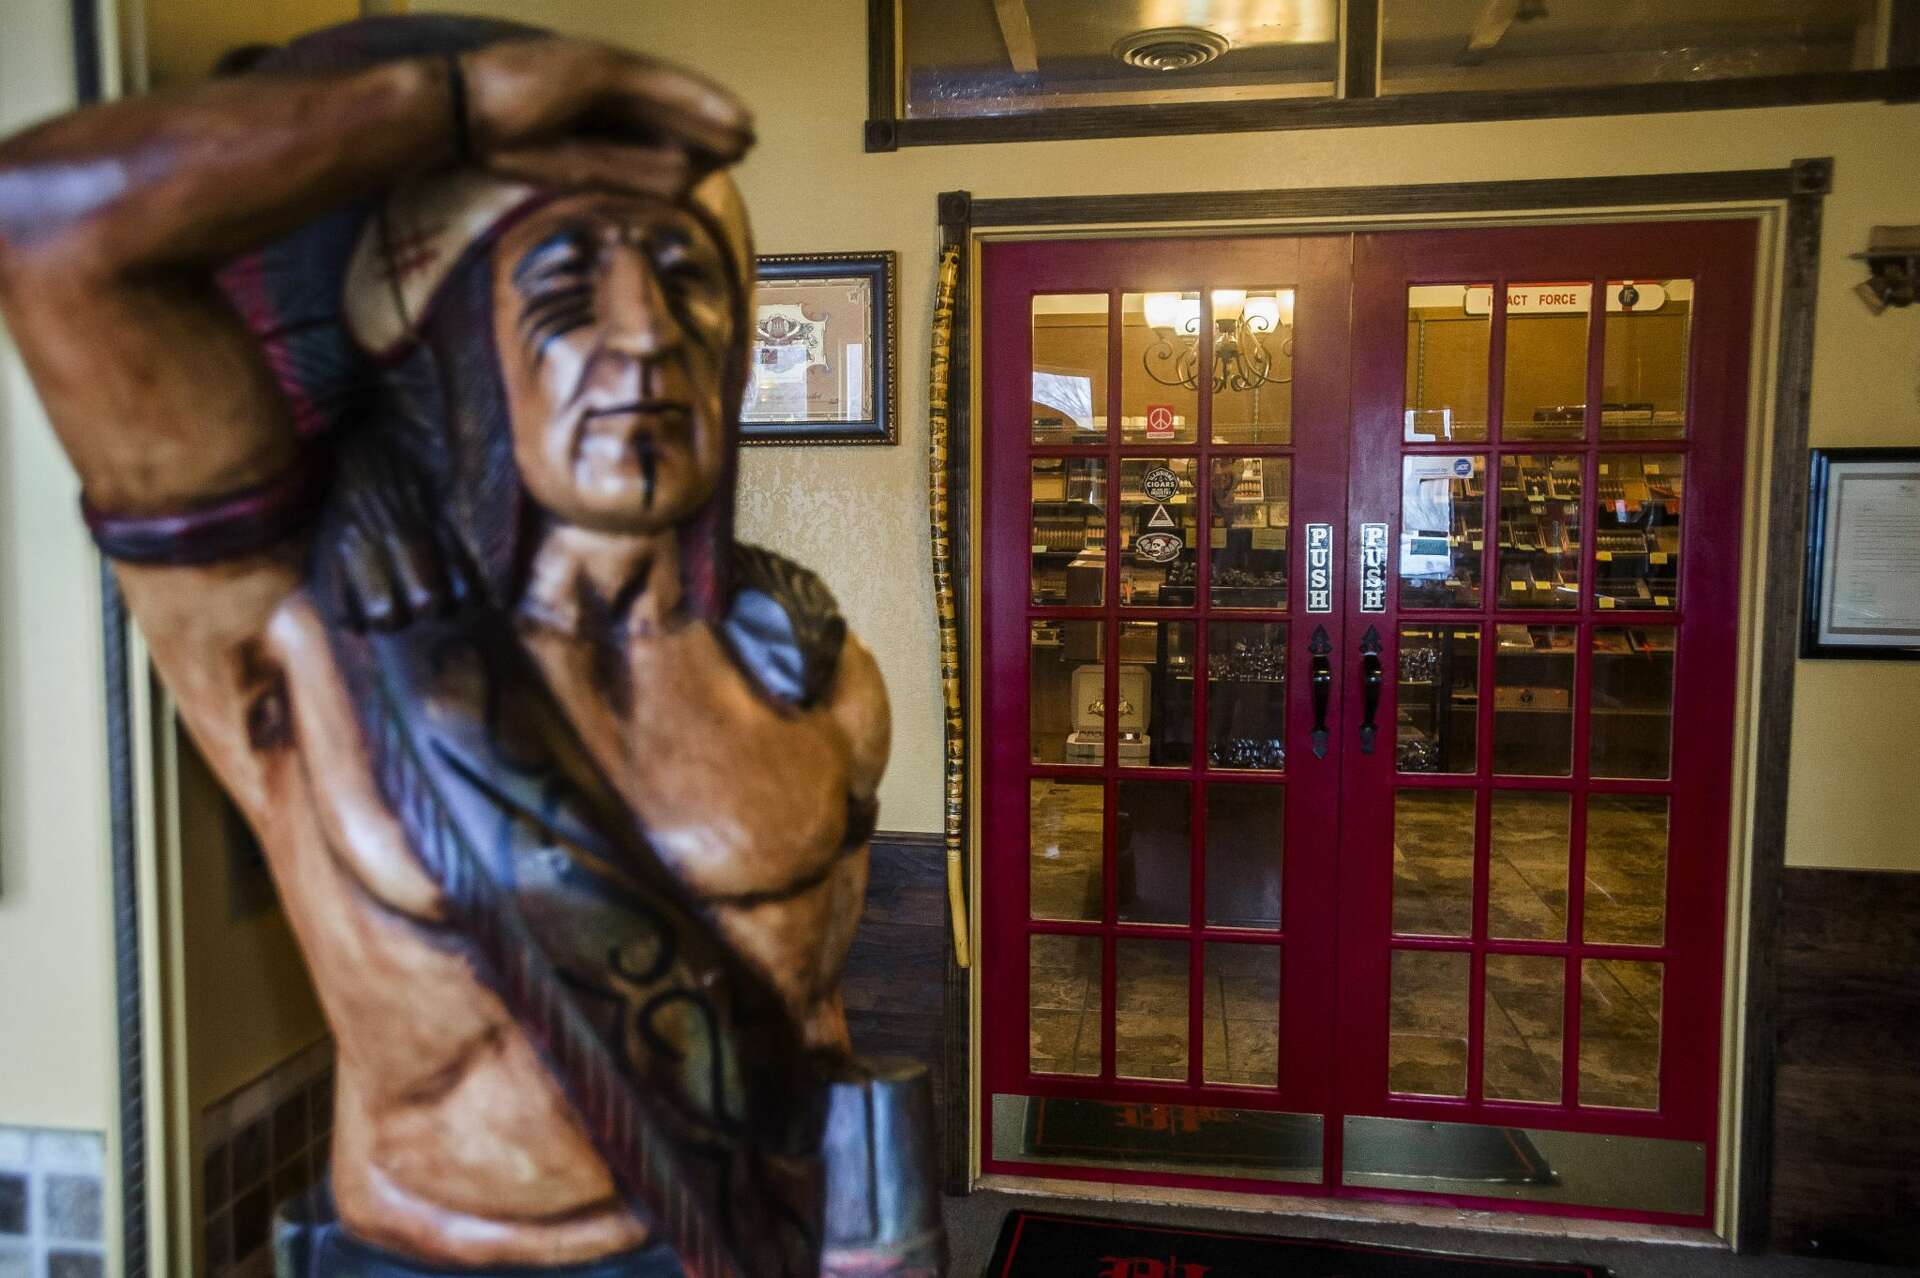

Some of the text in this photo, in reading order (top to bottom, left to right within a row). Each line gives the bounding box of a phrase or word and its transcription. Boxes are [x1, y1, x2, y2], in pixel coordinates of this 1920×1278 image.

[1487, 293, 1577, 307] IACT FORCE
[1309, 527, 1329, 608] PUSH
[1364, 527, 1384, 608] PUSH
